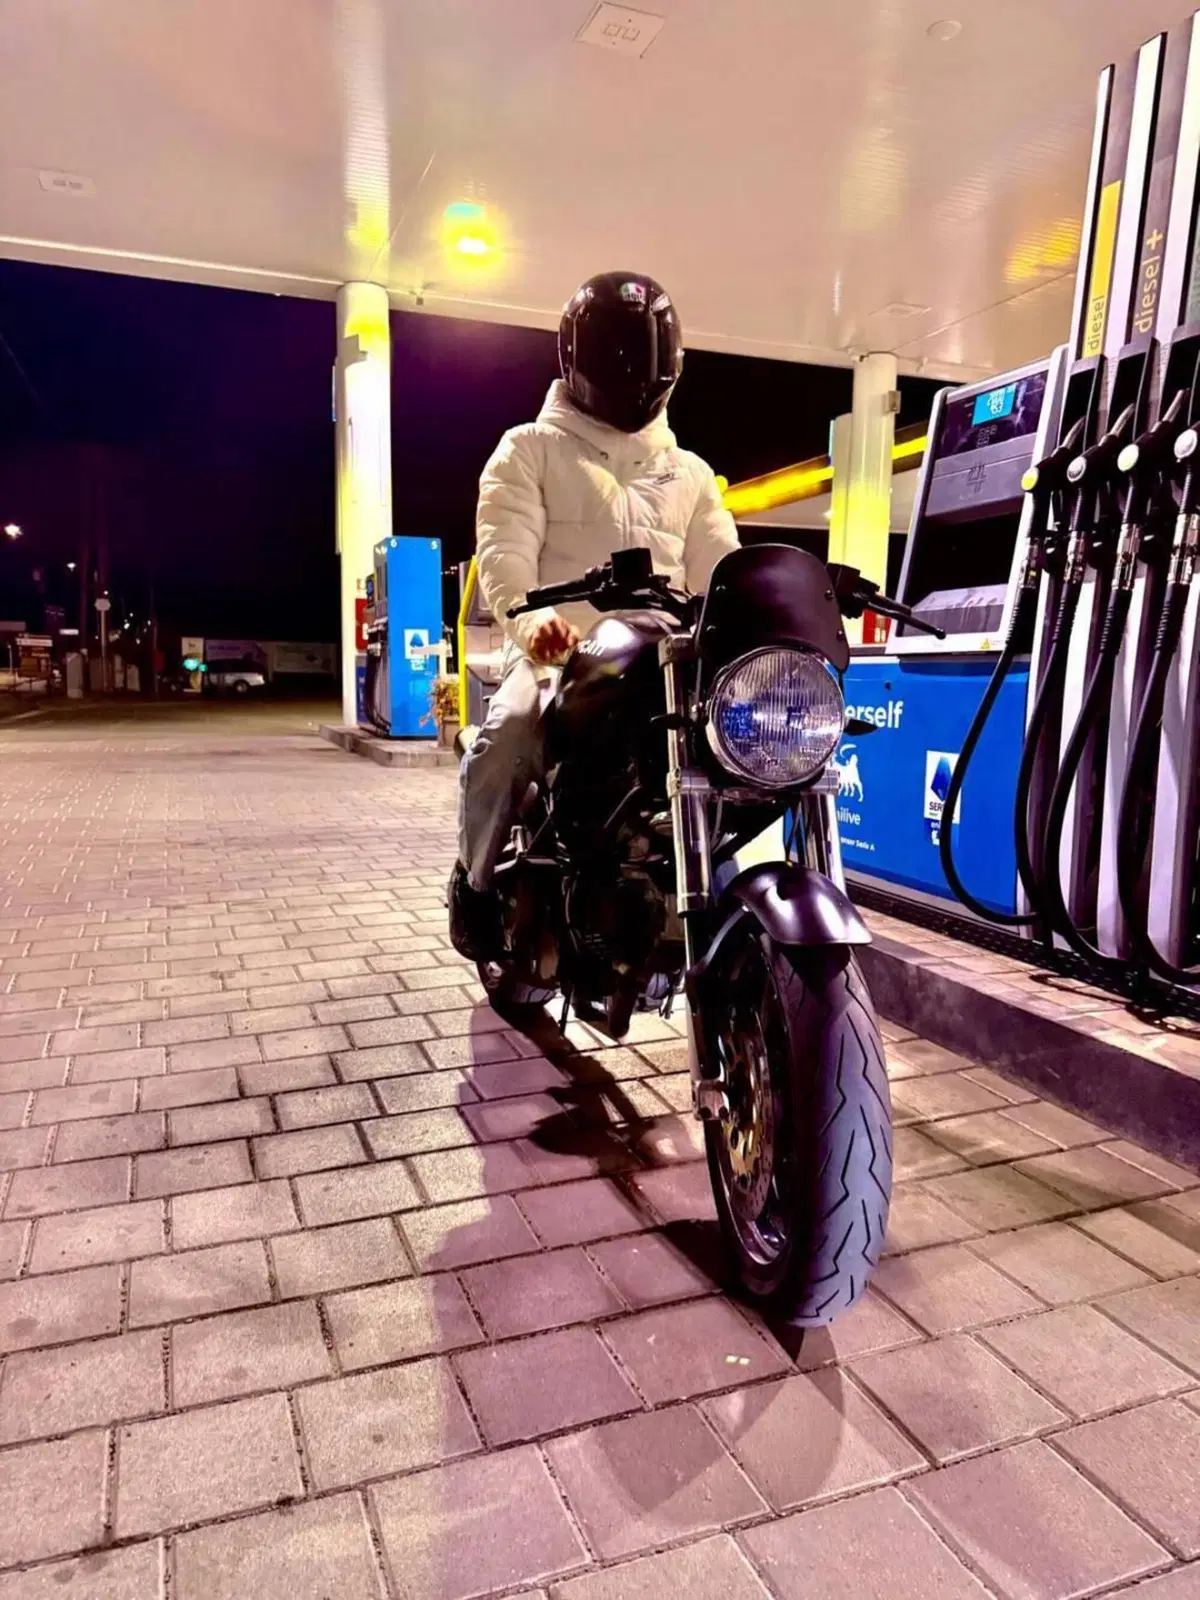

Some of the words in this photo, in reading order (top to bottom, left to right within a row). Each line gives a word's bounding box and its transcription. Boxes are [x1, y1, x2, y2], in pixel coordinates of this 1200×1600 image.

[1134, 256, 1160, 333] diesel
[1088, 295, 1105, 350] diesel
[845, 700, 904, 728] erself
[929, 801, 944, 812] SER
